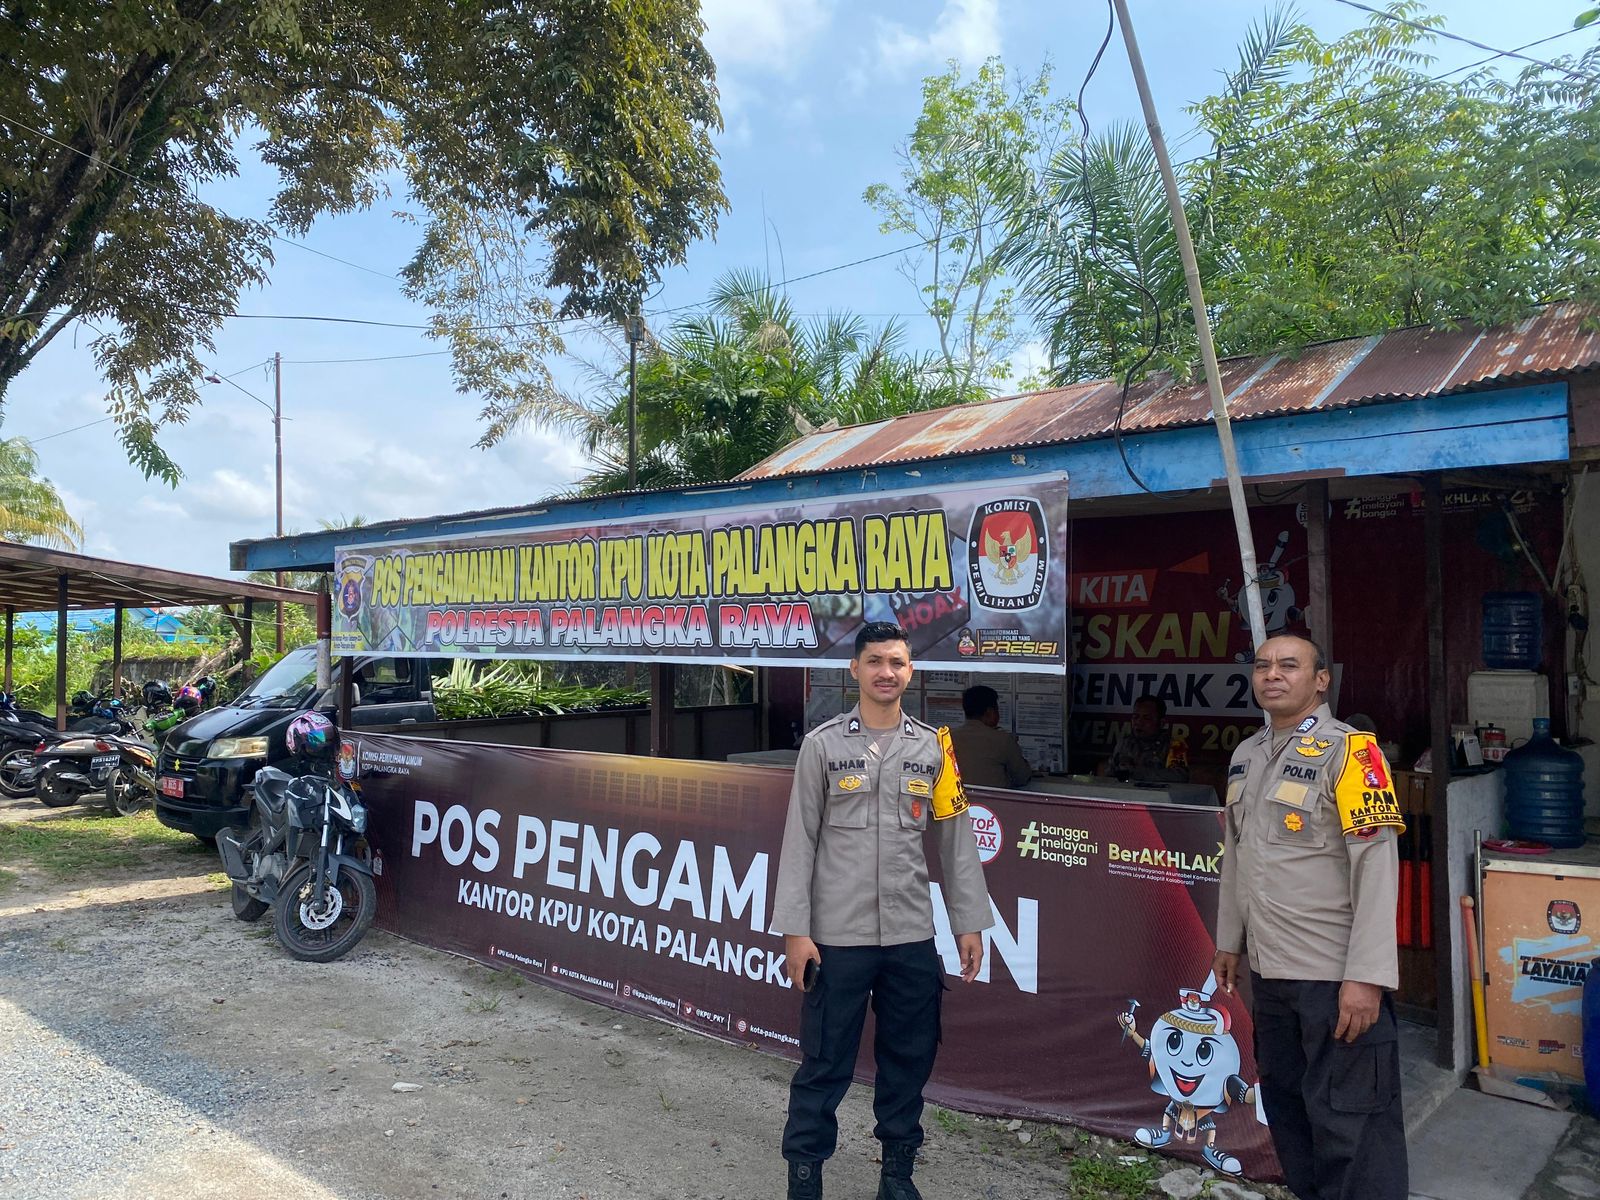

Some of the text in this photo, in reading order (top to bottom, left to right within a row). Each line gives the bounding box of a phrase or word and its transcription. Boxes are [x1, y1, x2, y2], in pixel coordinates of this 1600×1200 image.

[984, 501, 1030, 515] KOMISI
[1361, 510, 1397, 519] bangsa
[371, 510, 955, 606] POS PENGAMANAN KANTOR KPU KOTA PALANGKA RAYA
[971, 562, 1024, 607] PEMILIHAN
[1027, 560, 1046, 604] UMUM
[1081, 574, 1149, 604] KITA
[425, 602, 818, 648] POLRESTA PALANGKA RAYA
[981, 641, 1058, 655] PRESISI
[829, 760, 865, 772] ILHAM
[903, 762, 935, 774] POLRI
[1283, 765, 1316, 781] POLRI
[1362, 790, 1395, 806] PAM
[1350, 805, 1391, 817] KANTOR
[411, 800, 502, 873] POS
[1041, 822, 1089, 840] bangga
[1041, 838, 1098, 854] melayani
[1041, 849, 1088, 867] bangsa
[1109, 843, 1221, 874] BerAKHLAK
[458, 879, 793, 989] KANTOR KPU KOTA PALANGK
[695, 1008, 725, 1024] @KPU_PKY
